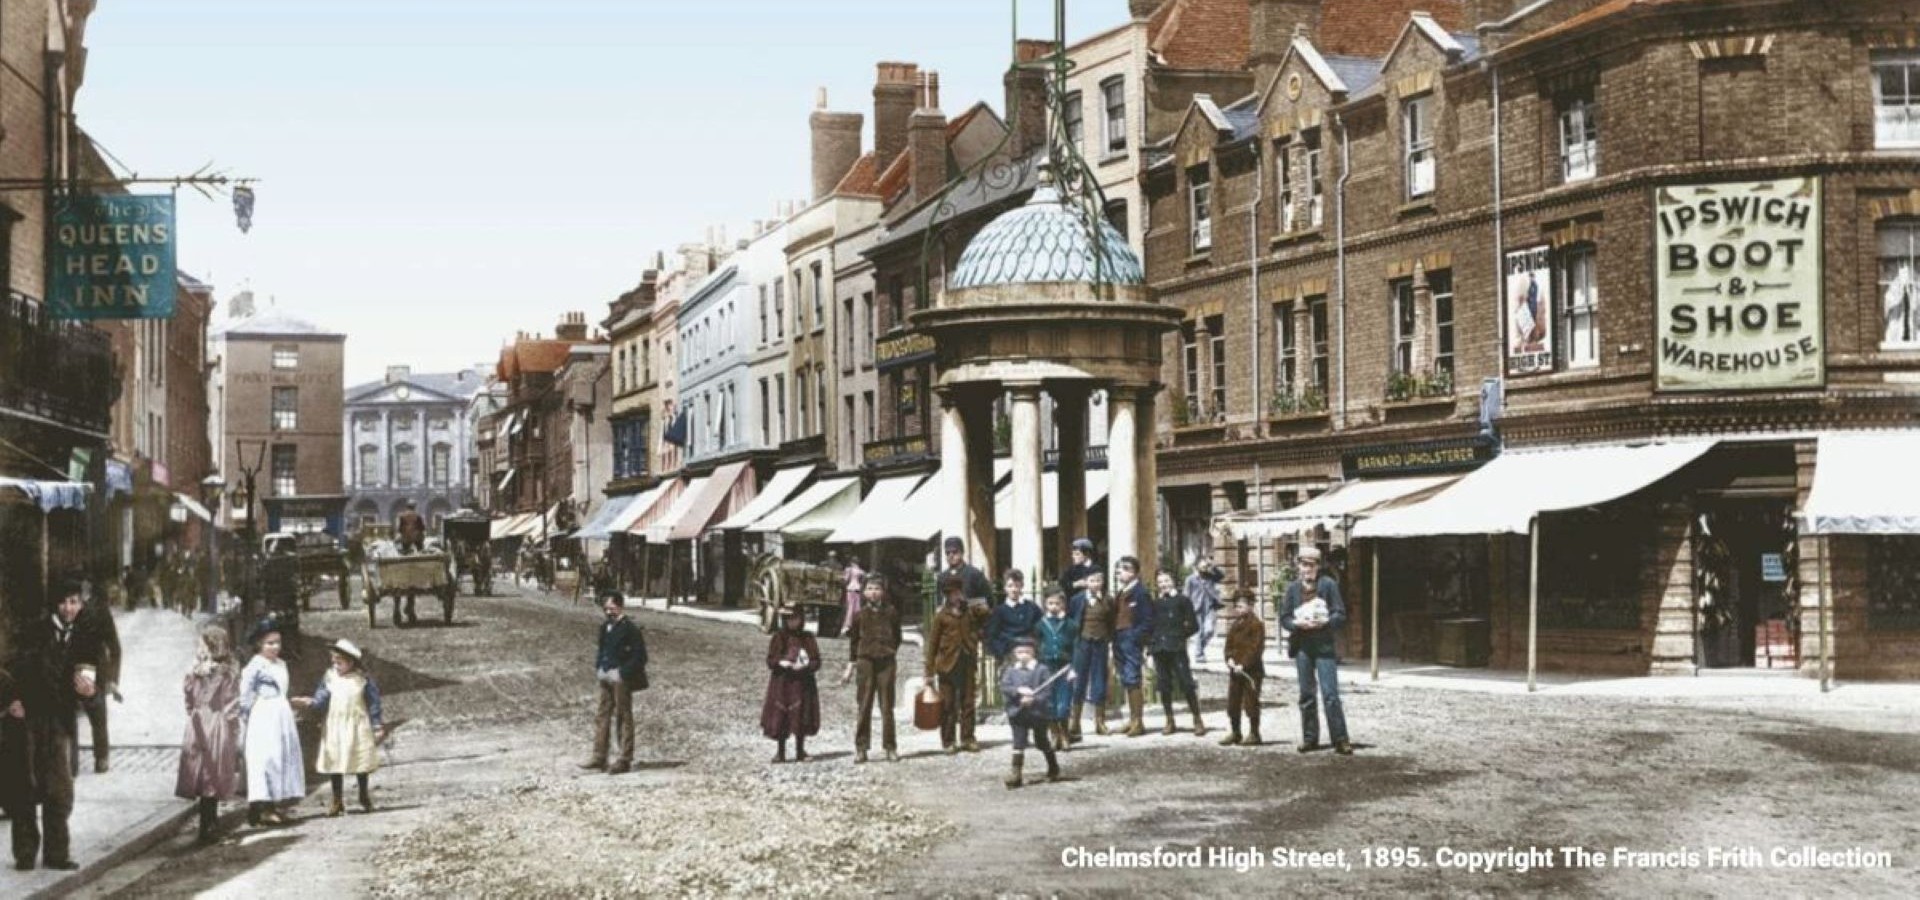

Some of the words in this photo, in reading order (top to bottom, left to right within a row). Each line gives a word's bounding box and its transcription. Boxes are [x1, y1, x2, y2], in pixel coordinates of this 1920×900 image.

[1659, 196, 1811, 238] IPSWICH
[59, 223, 169, 248] QUEENS
[66, 254, 159, 275] HEAD
[1506, 249, 1550, 277] IPSWICH
[1668, 238, 1804, 274] BOOT
[75, 284, 151, 306] INN
[1728, 276, 1747, 296] &
[1669, 302, 1802, 336] SHOE
[1662, 336, 1817, 372] WAREHOUSE
[1357, 453, 1402, 471] BARNARD
[1405, 447, 1474, 466] UPHOLSTERER
